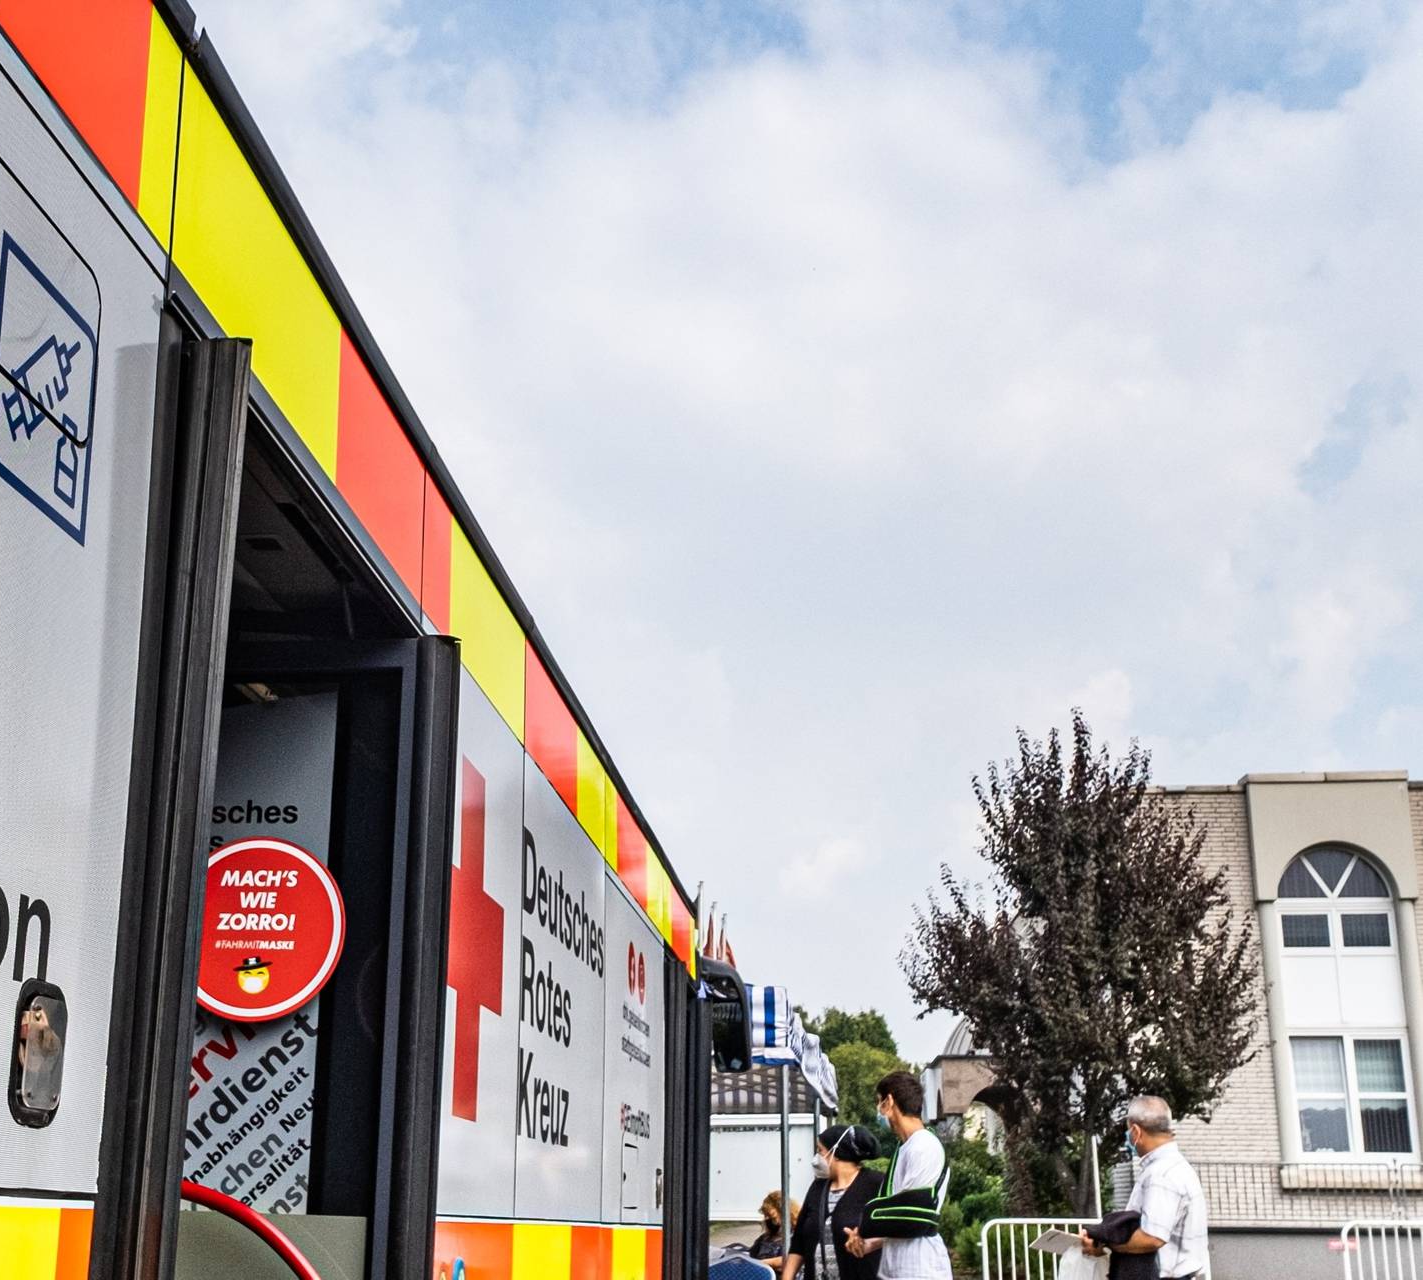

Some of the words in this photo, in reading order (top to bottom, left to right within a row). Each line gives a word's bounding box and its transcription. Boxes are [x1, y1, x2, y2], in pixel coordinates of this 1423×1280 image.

[212, 799, 299, 824] sches
[220, 870, 299, 888] MACH'S
[239, 891, 277, 909] WIE
[523, 826, 604, 978] Deutsches
[216, 913, 296, 931] ZORRO!
[214, 939, 295, 951] #FAHRMITMASKE
[521, 936, 572, 1048] Rotes
[517, 1047, 570, 1147] Kreuz
[182, 1066, 310, 1185] nabhängigkeit
